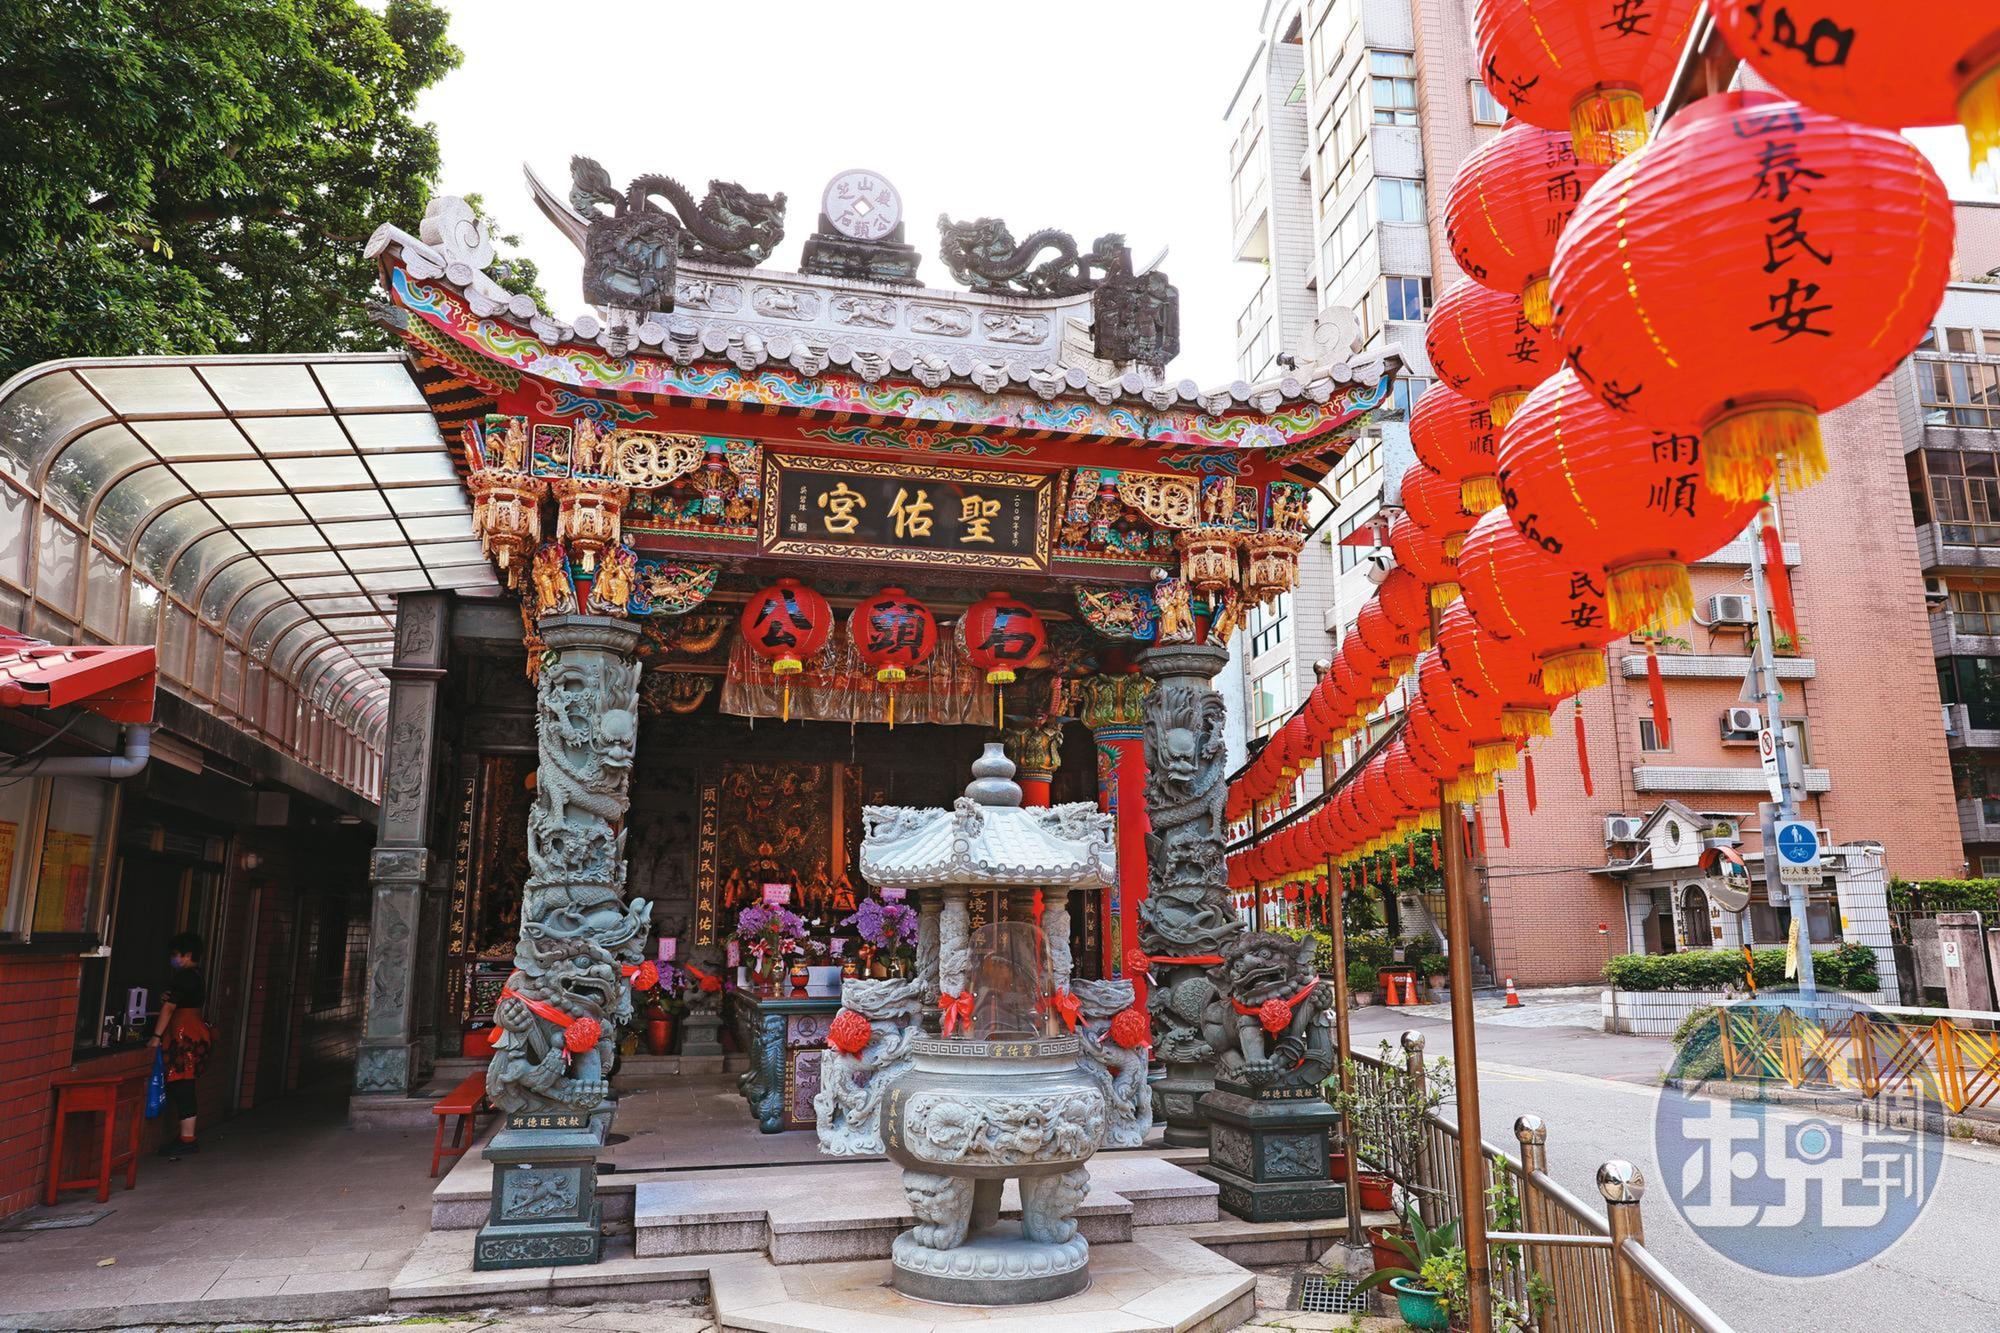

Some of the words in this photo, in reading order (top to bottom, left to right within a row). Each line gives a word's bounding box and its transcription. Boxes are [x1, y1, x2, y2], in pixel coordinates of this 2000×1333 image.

[1646, 431, 1699, 518] 雨順
[817, 482, 1002, 544] 聖佑宮
[753, 589, 813, 648] 公
[867, 601, 926, 659] 頭
[1561, 571, 1604, 630] 民安
[977, 606, 1038, 660] 石
[1781, 866, 1821, 875] 行人優先
